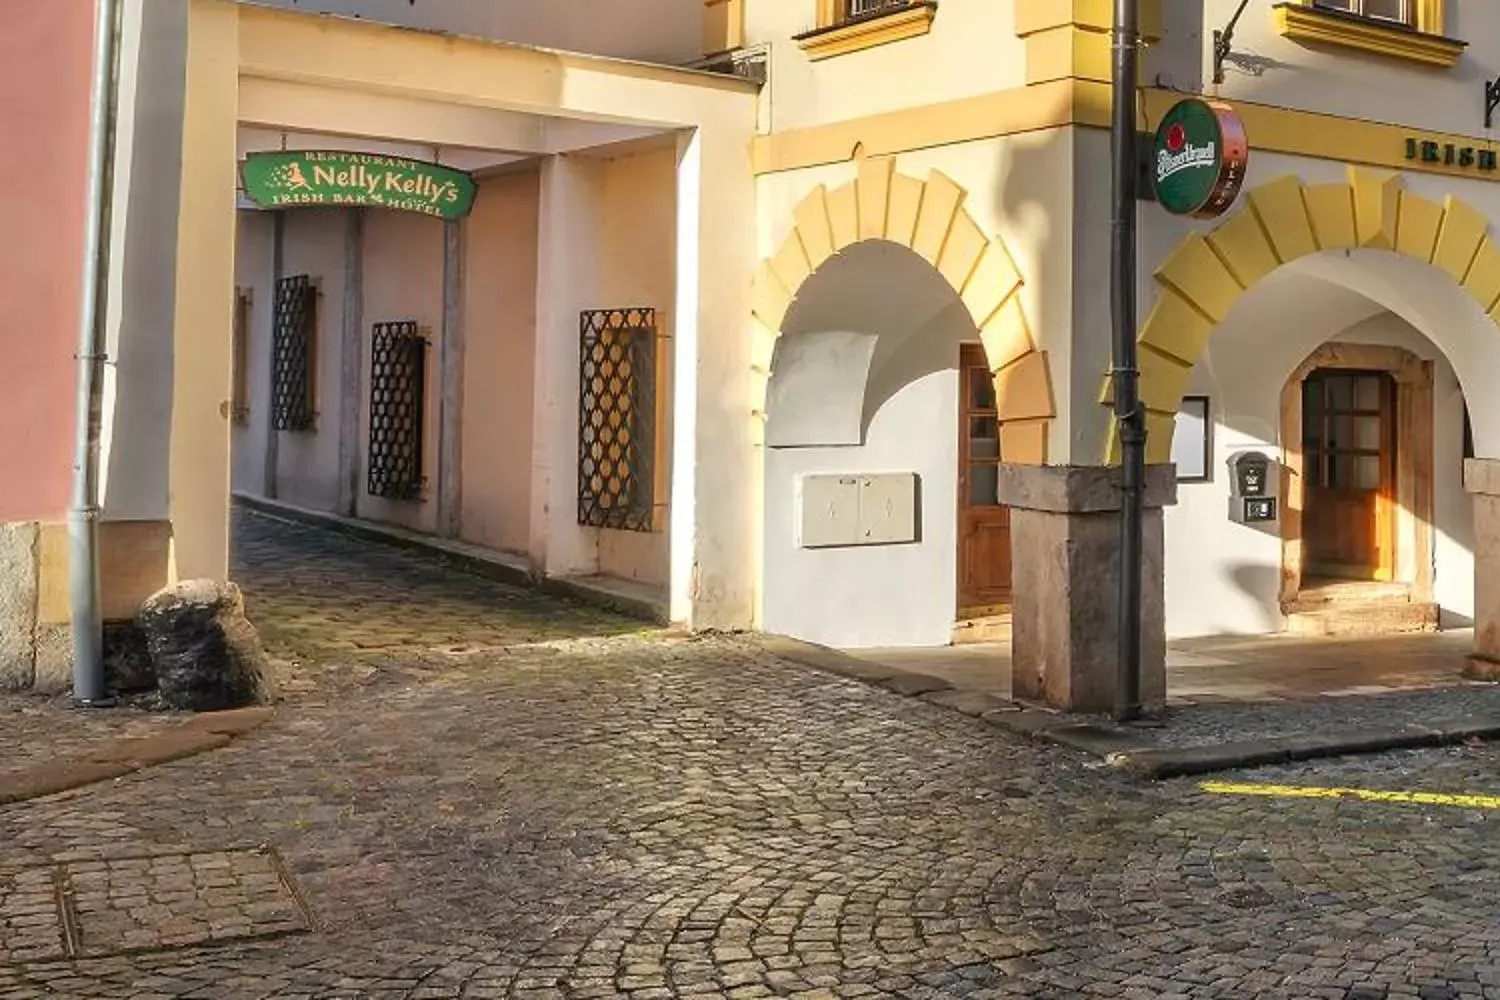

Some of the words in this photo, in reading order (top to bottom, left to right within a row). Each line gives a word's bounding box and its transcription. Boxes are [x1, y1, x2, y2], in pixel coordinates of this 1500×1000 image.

[304, 151, 418, 171] RESTAURANT
[1405, 138, 1497, 170] IRISH
[313, 165, 384, 194] Nelly
[385, 171, 459, 203] Kelly's
[271, 192, 324, 205] IRISH
[332, 193, 366, 204] BAR
[387, 198, 444, 217] HOTEL
